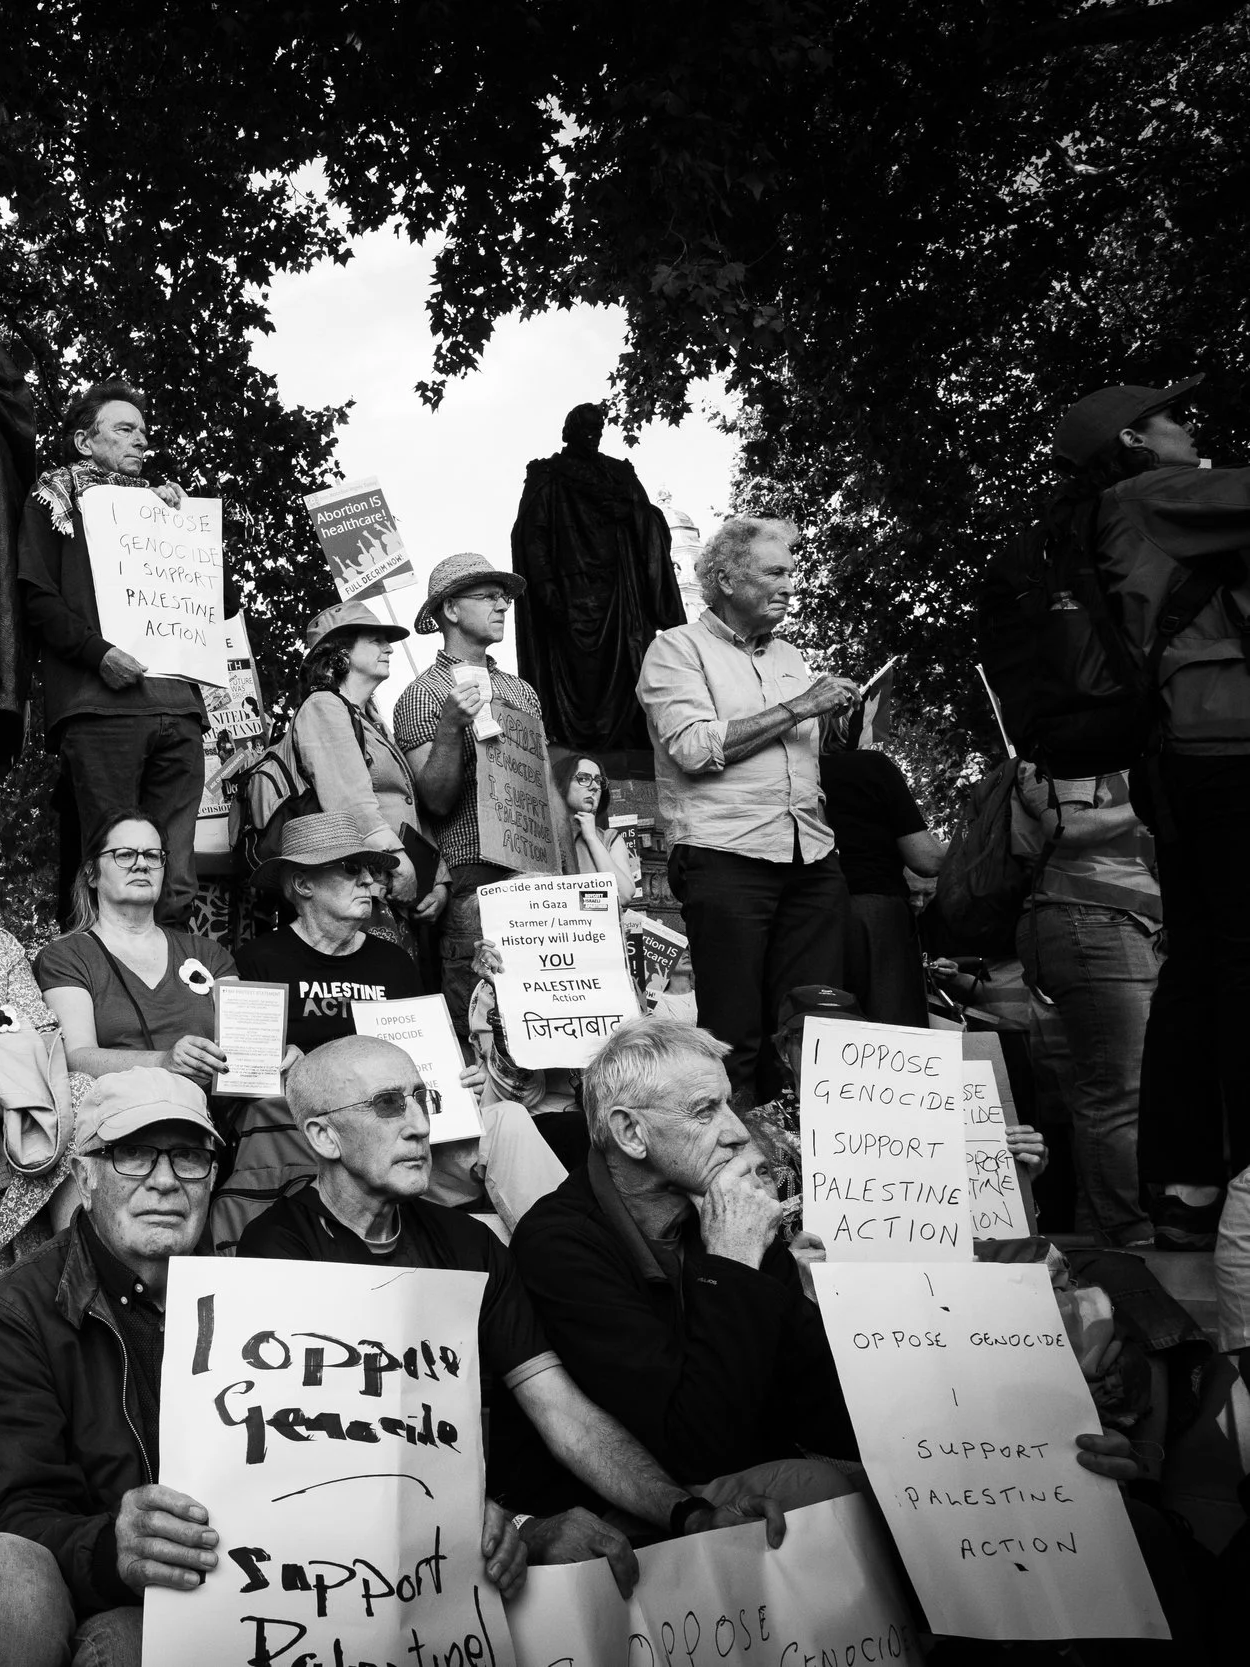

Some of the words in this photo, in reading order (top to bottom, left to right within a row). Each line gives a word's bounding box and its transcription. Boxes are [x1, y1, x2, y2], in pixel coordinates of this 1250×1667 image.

[139, 505, 211, 532] OPPOSE
[317, 500, 368, 525] Abortion
[369, 495, 382, 508] IS
[320, 509, 388, 538] healthcare!
[119, 533, 223, 568] GENOCIDE
[143, 562, 219, 590] SUPPORT
[344, 582, 362, 595] FULL
[361, 564, 388, 585] DECRIM
[386, 553, 405, 569] NOW!
[126, 588, 216, 624] PALESTINE
[145, 619, 207, 647] ACTION
[486, 743, 543, 789] GENOCIDE
[488, 774, 498, 801] I
[503, 829, 548, 864] ACTION
[480, 884, 532, 897] Genocide
[534, 882, 554, 892] and
[556, 878, 613, 891] starvation
[529, 900, 540, 910] in
[543, 900, 568, 910] Gaza
[509, 918, 548, 929] Starmer
[558, 918, 593, 928] Lammy
[501, 934, 545, 947] History
[547, 933, 569, 944] will
[572, 931, 606, 943] Judge
[666, 945, 678, 958] IS
[539, 953, 575, 968] YOU
[299, 981, 387, 1001] PALESTINE
[522, 979, 602, 993] PALESTINE
[552, 993, 586, 1003] Action
[381, 1014, 417, 1026] OPPOSE
[813, 1038, 820, 1065] I
[841, 1042, 943, 1077] OPPOSE
[813, 1079, 956, 1111] GENOCIDE
[812, 1129, 816, 1157] I
[833, 1132, 945, 1160] SUPPORT
[812, 1172, 962, 1205] PALESTINE
[833, 1214, 959, 1248] ACTION
[191, 1293, 216, 1376] I
[852, 1330, 947, 1350] OPPOSE
[969, 1332, 1065, 1348] GENOCIDE
[916, 1439, 1050, 1460] SUPPORT
[903, 1485, 1074, 1510] PALESTINE
[960, 1532, 1078, 1560] ACTION
